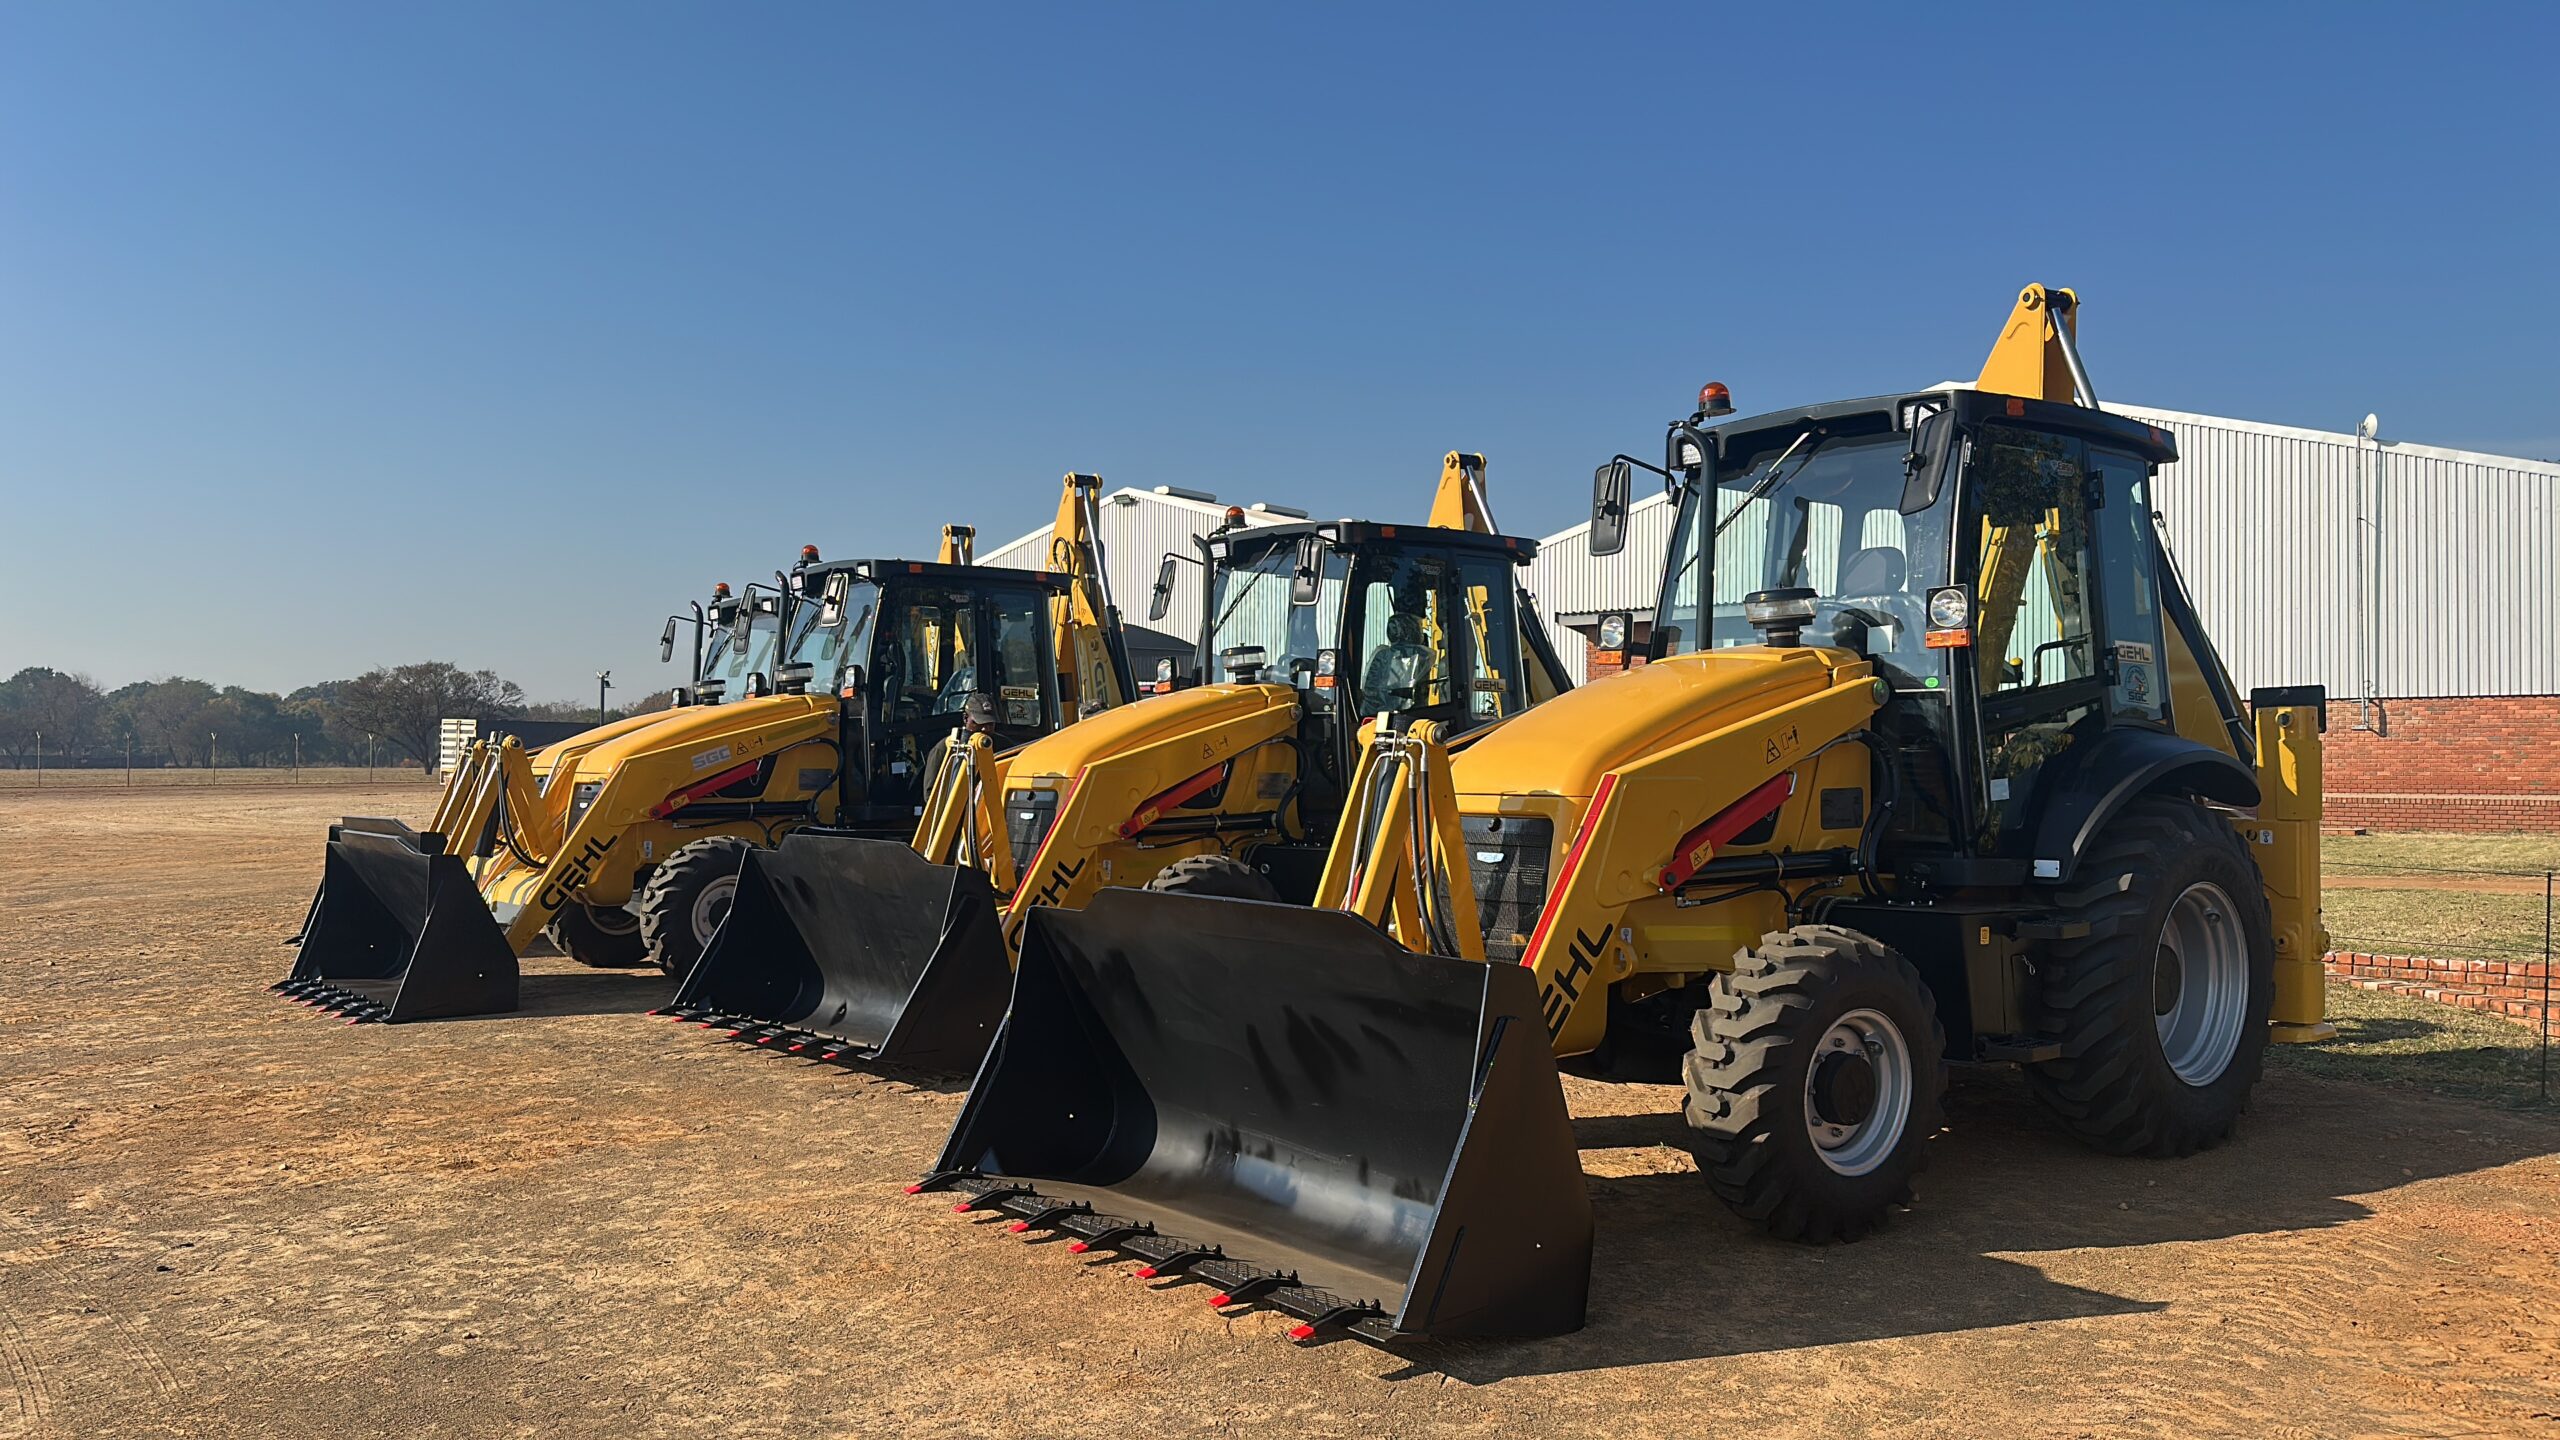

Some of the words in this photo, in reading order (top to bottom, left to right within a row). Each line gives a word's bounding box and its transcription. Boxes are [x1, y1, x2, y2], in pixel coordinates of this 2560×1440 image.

[2118, 645, 2149, 660] GEHL
[1003, 688, 1032, 697] GEHL
[1474, 681, 1504, 690] GEHL
[2128, 691, 2147, 702] SGC
[693, 747, 730, 769] SGC
[540, 835, 617, 910] GEHL
[1009, 858, 1085, 952] GHL
[1541, 923, 1613, 1042] EHL
